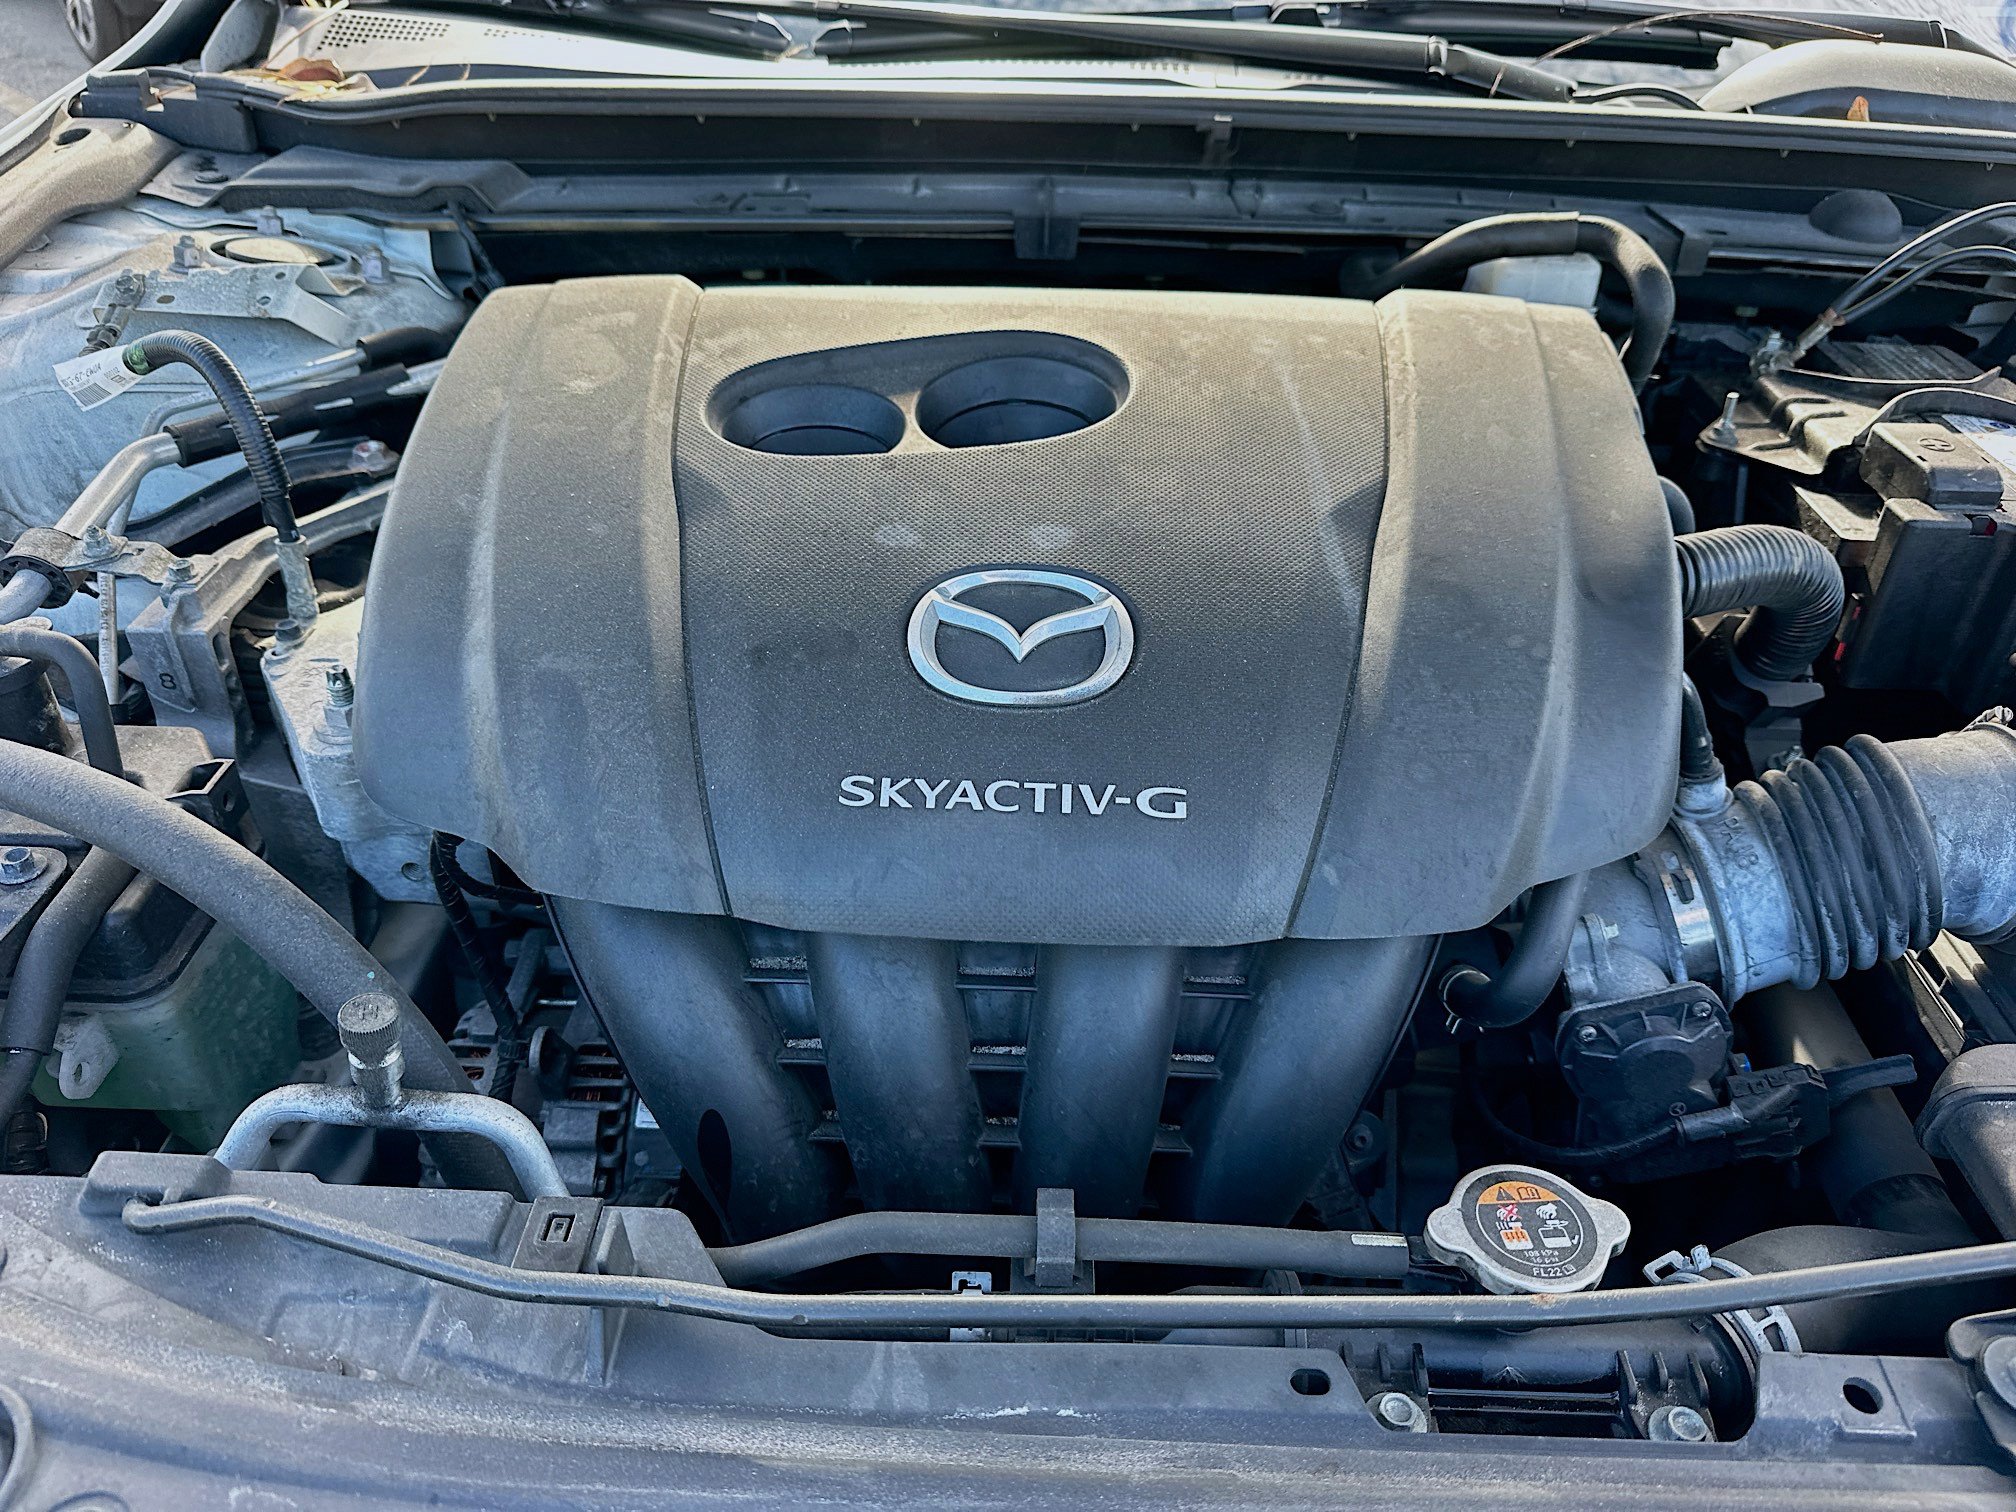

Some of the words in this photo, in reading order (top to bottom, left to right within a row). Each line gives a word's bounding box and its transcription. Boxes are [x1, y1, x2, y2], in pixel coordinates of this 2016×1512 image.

[159, 672, 177, 690] 8
[838, 774, 1188, 820] SKYACTIV-G
[1532, 1266, 1562, 1277] FL22
